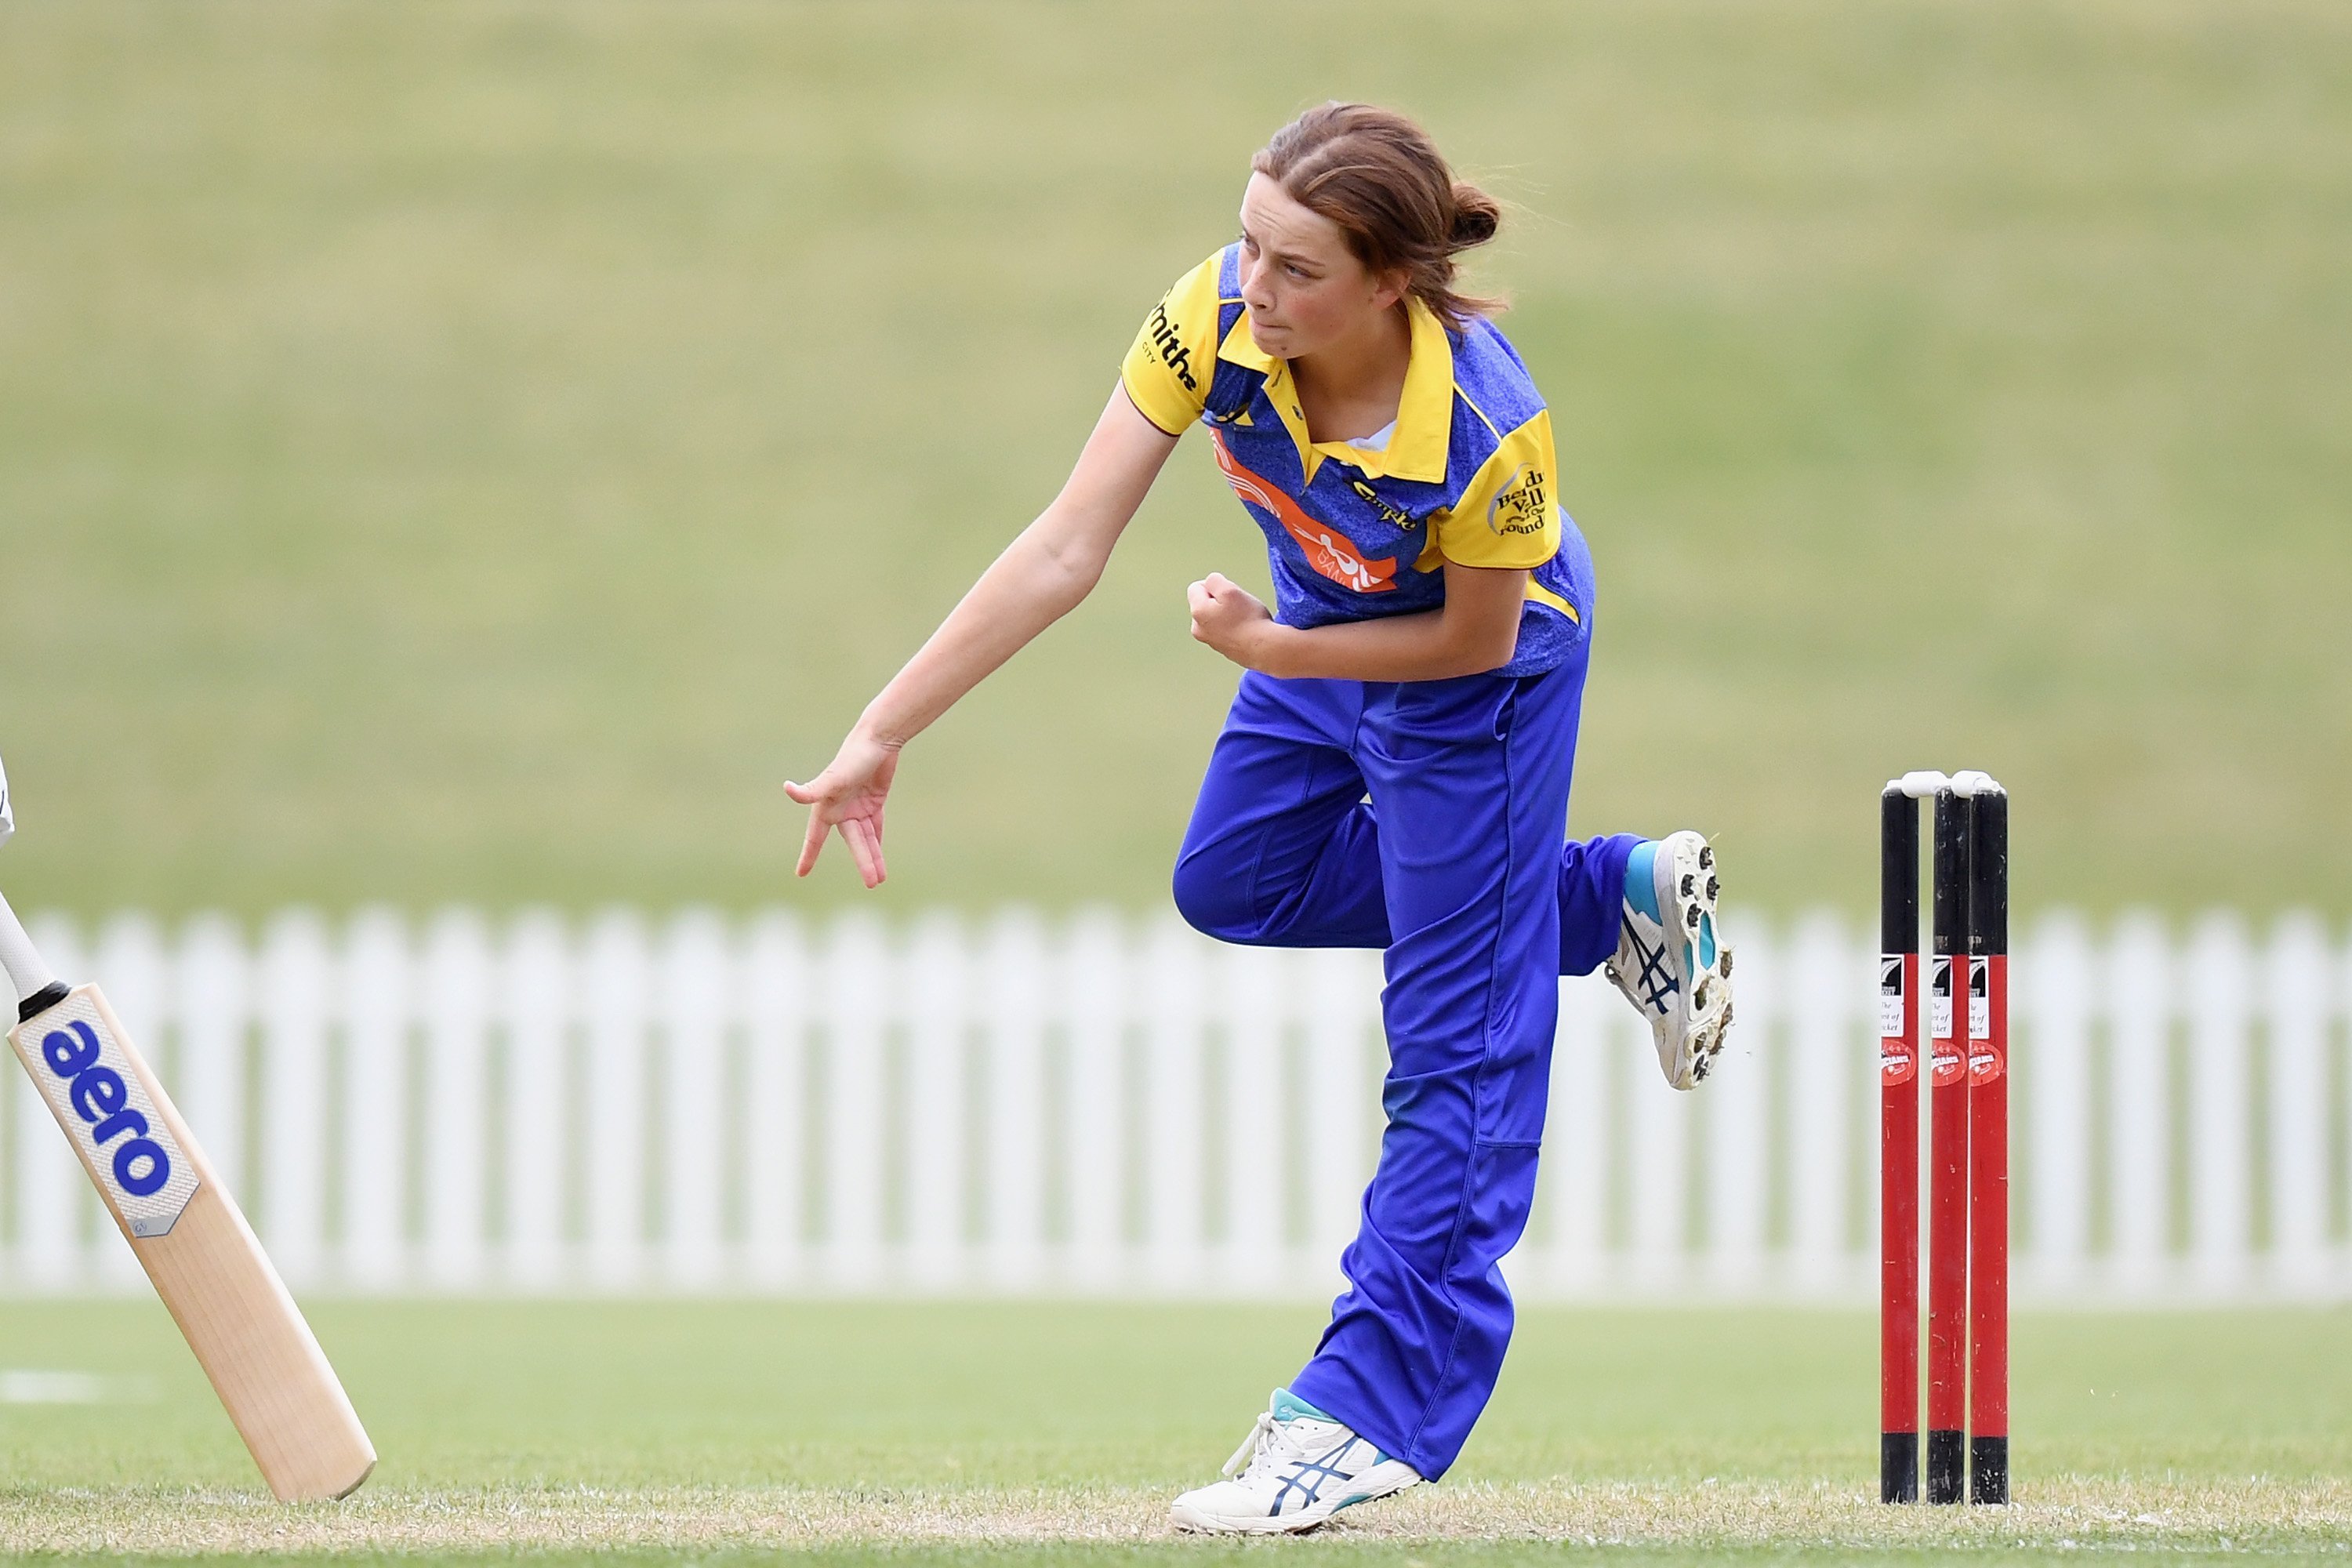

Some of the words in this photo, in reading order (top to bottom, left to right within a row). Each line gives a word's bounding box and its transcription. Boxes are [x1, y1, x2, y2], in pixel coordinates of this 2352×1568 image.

[1142, 341, 1156, 365] CITY
[1150, 284, 1197, 392] miths
[1317, 549, 1347, 586] BAN
[42, 1019, 171, 1196] aero
